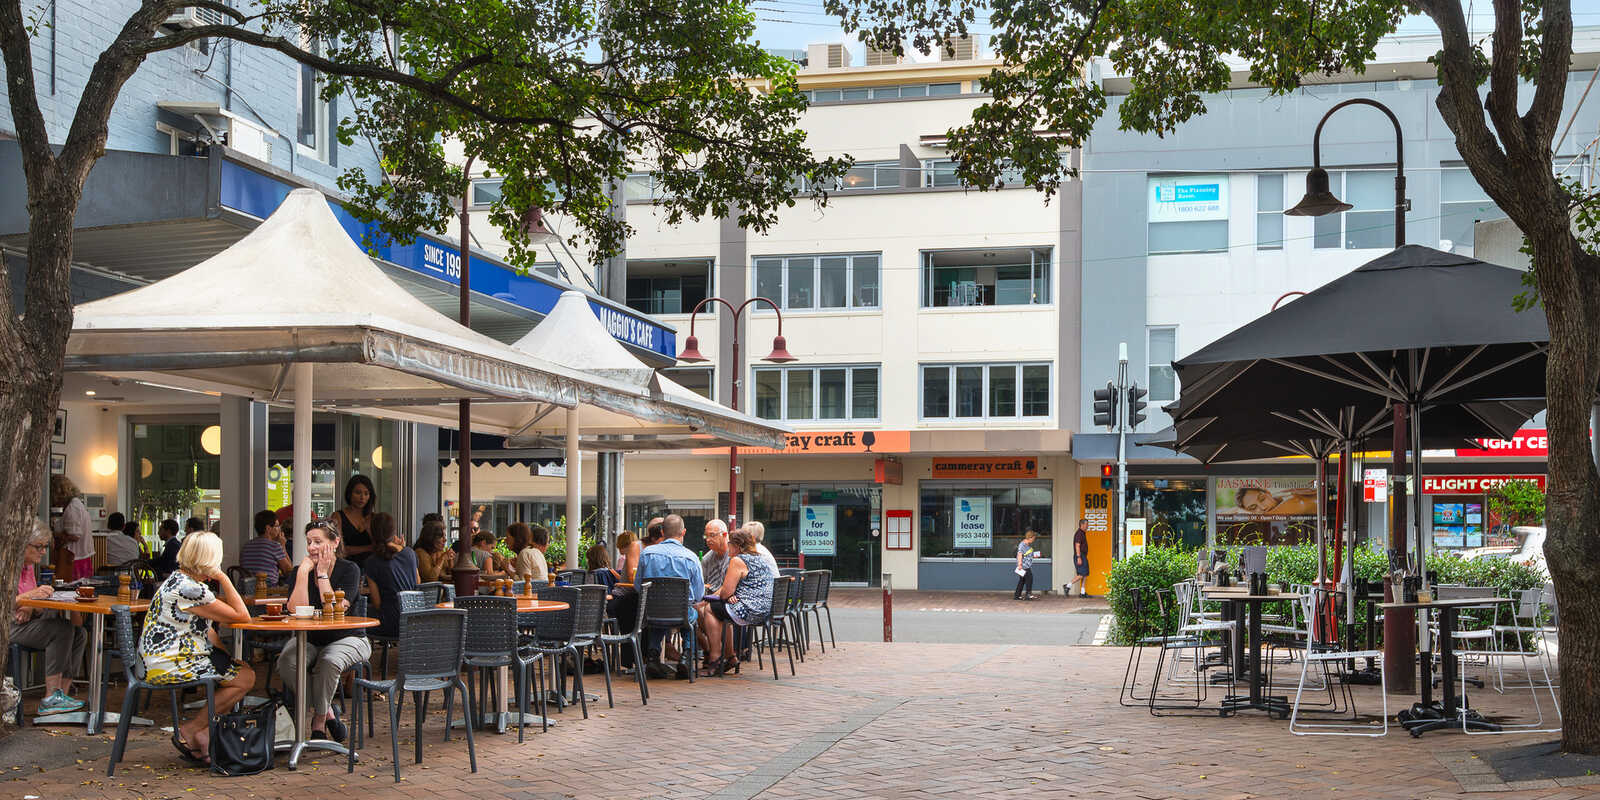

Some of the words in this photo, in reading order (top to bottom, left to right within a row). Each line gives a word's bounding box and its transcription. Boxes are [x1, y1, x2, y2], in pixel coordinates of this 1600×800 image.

[424, 244, 444, 266] SINCE
[446, 252, 461, 279] 199
[600, 306, 636, 343] MAGGIO'S
[636, 320, 654, 349] CAFE
[815, 432, 856, 446] craft
[1526, 436, 1548, 449] CE
[936, 464, 993, 472] cammeray
[995, 460, 1023, 470] craft
[1218, 480, 1272, 488] JASMINE
[1424, 479, 1478, 490] FLIGHT
[1084, 494, 1108, 508] 506
[966, 512, 980, 520] for
[811, 520, 824, 528] for
[806, 528, 829, 537] lease
